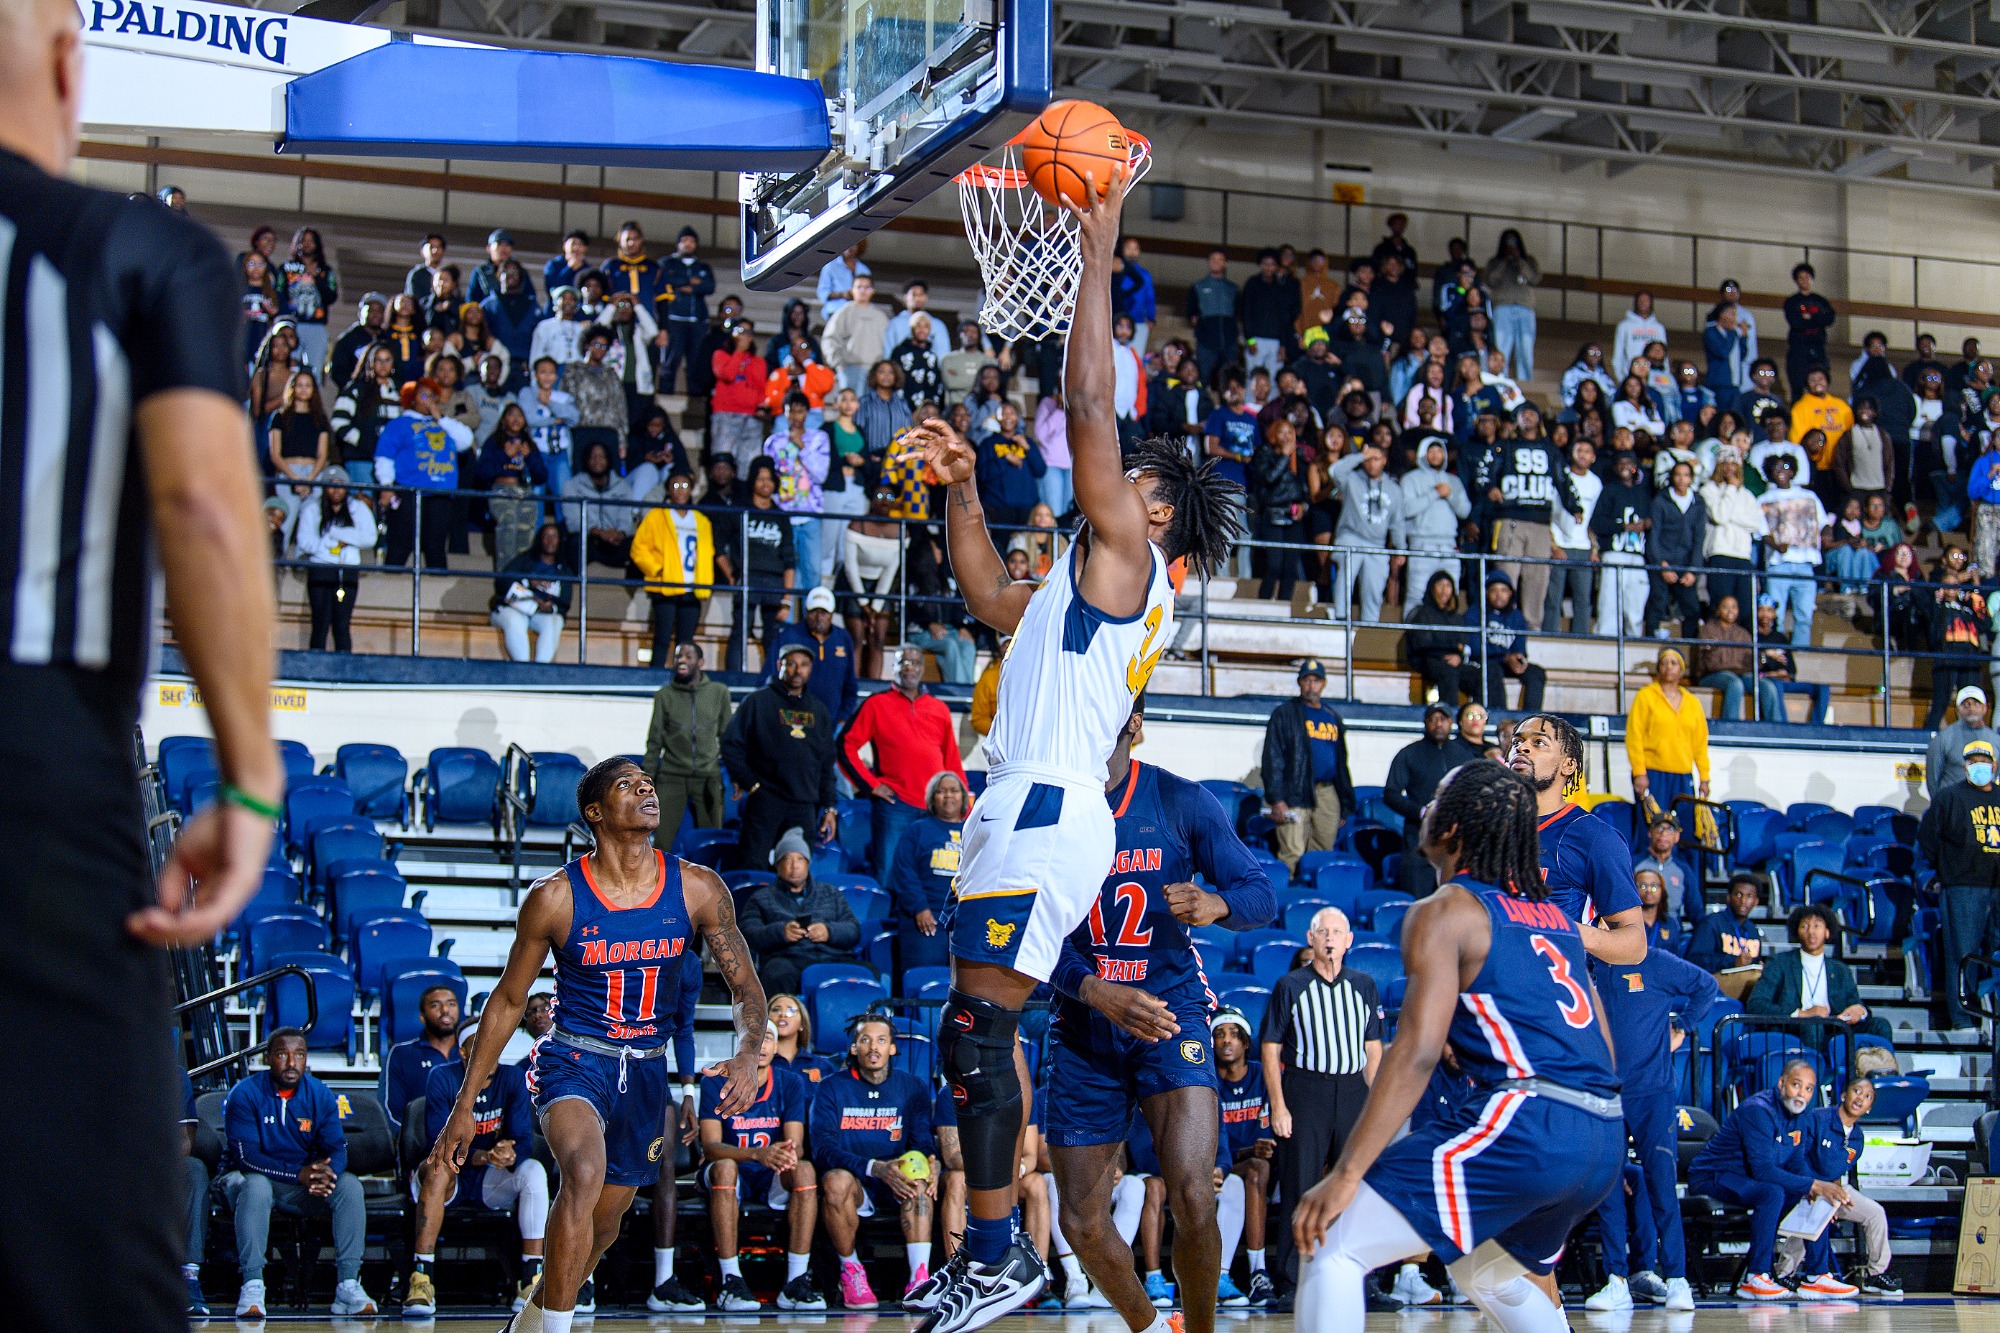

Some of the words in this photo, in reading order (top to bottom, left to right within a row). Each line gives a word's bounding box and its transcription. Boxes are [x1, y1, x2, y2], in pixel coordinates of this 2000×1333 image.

[89, 0, 289, 65] PALDING
[1515, 448, 1548, 474] 99
[684, 535, 697, 572] 8
[1110, 848, 1162, 876] GAN
[1088, 881, 1153, 947] 12
[1496, 893, 1570, 932] LAWSON
[577, 937, 685, 965] MORGAN
[1092, 952, 1149, 982] STATE
[600, 965, 661, 1022] 11
[1530, 934, 1594, 1029] 3
[731, 1115, 781, 1130] MORGAN
[876, 1107, 898, 1117] STATE
